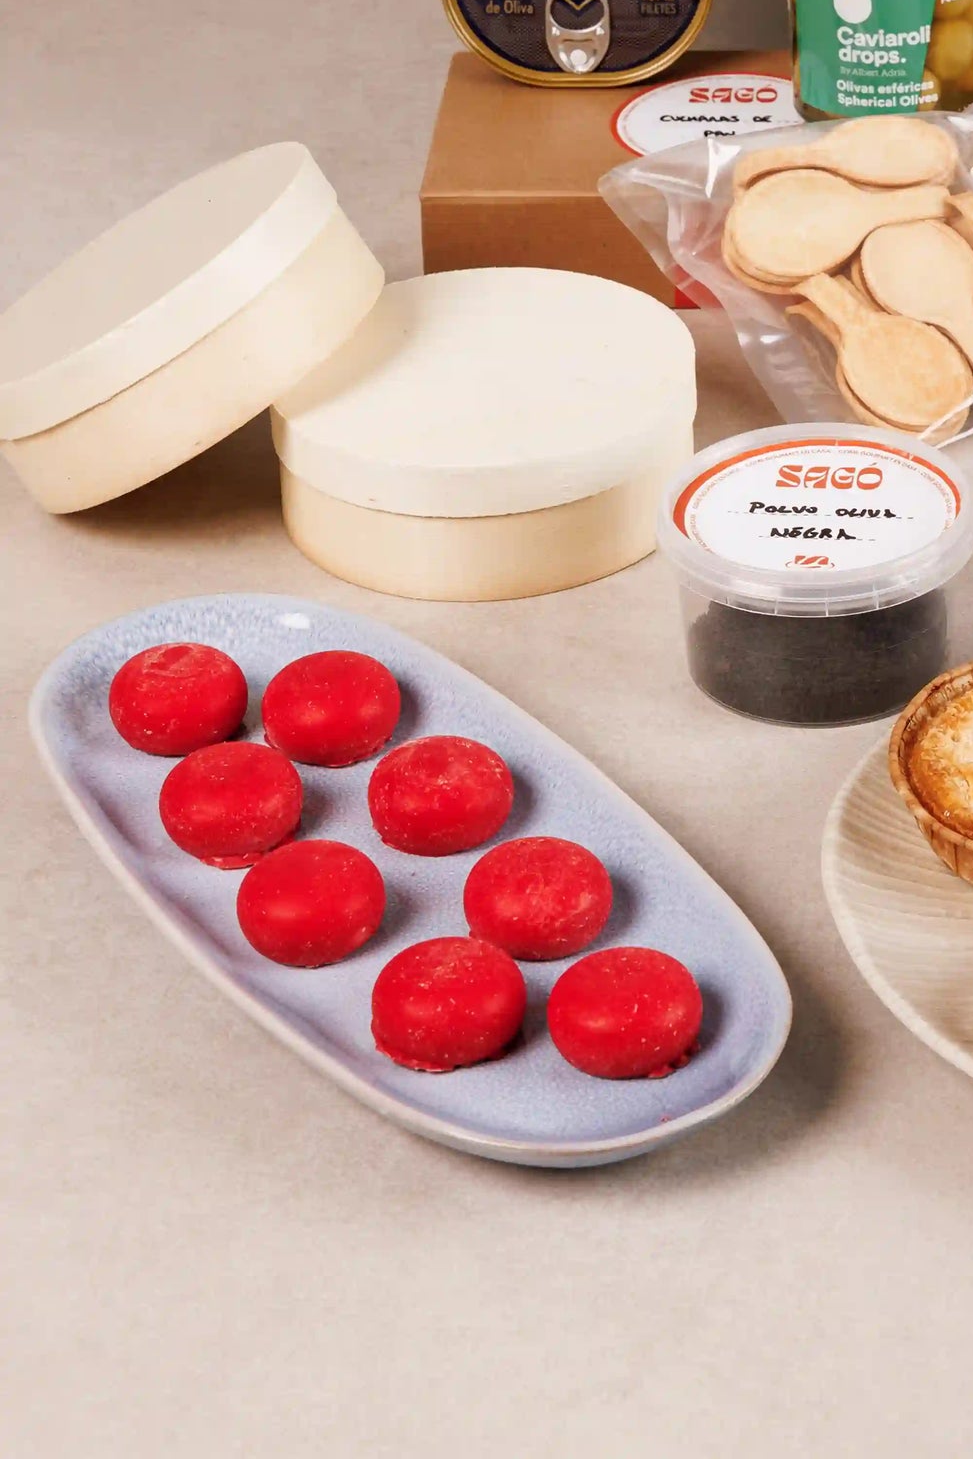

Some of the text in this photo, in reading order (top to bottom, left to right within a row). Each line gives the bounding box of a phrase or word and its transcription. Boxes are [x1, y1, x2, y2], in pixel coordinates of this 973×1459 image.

[485, 0, 534, 14] de Oliva
[837, 25, 931, 47] Caviaroli
[838, 45, 907, 67] drops.
[836, 80, 875, 94] Olivas
[837, 93, 939, 108] Spherical Olives
[775, 462, 883, 490] SAGÓ
[770, 526, 857, 540] NEGRA
